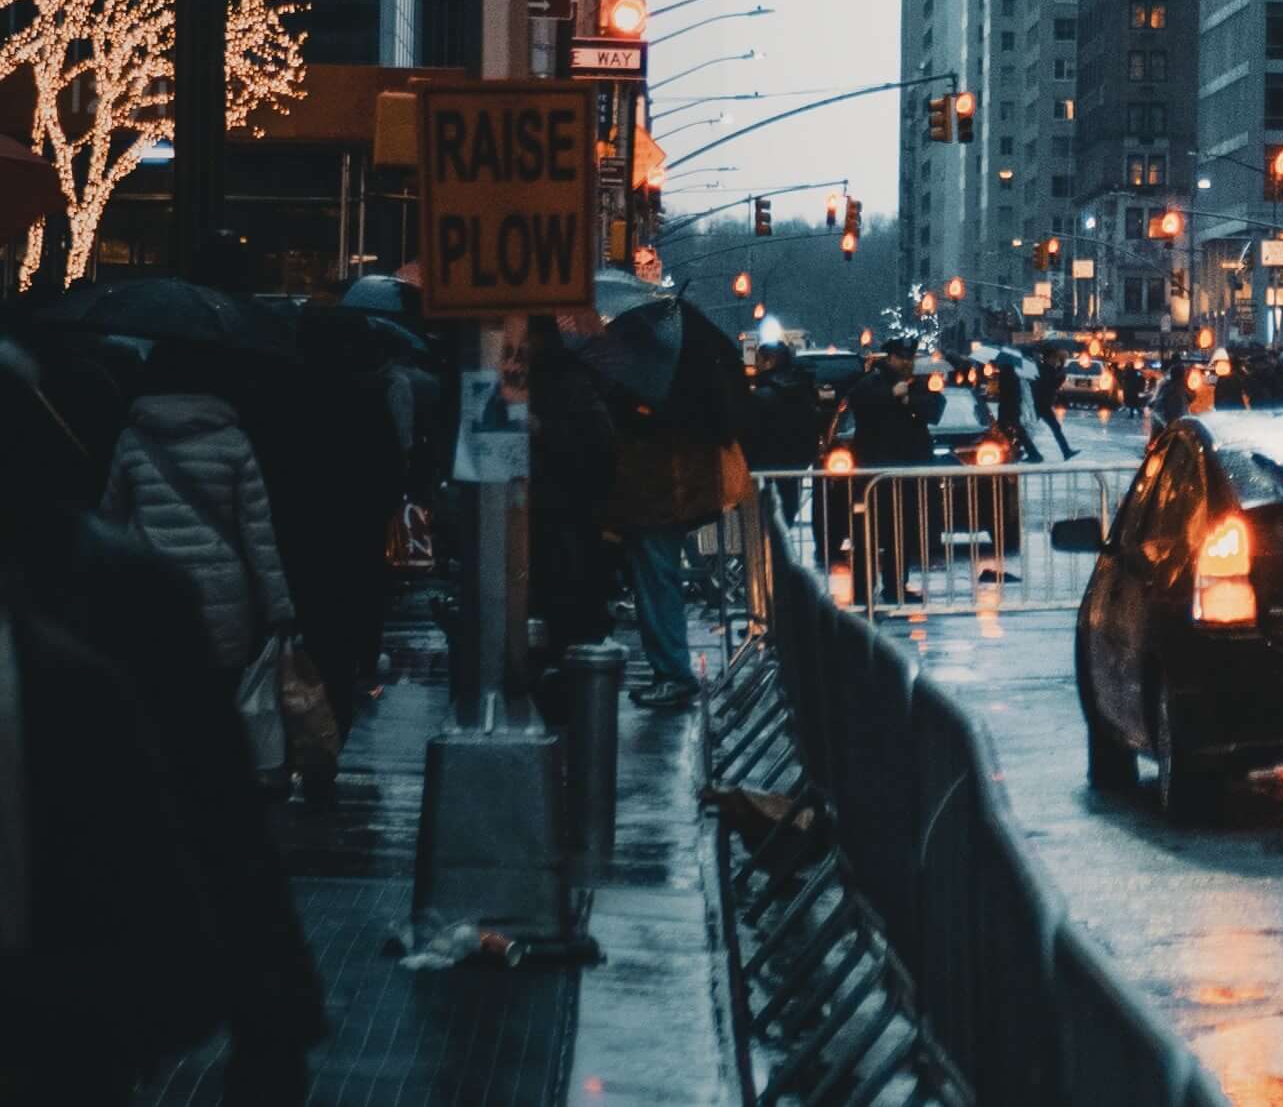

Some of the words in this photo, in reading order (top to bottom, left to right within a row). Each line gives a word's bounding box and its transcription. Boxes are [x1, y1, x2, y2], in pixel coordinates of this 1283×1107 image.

[597, 52, 633, 66] WAY
[433, 108, 577, 183] RAISE
[437, 213, 577, 288] PLOW
